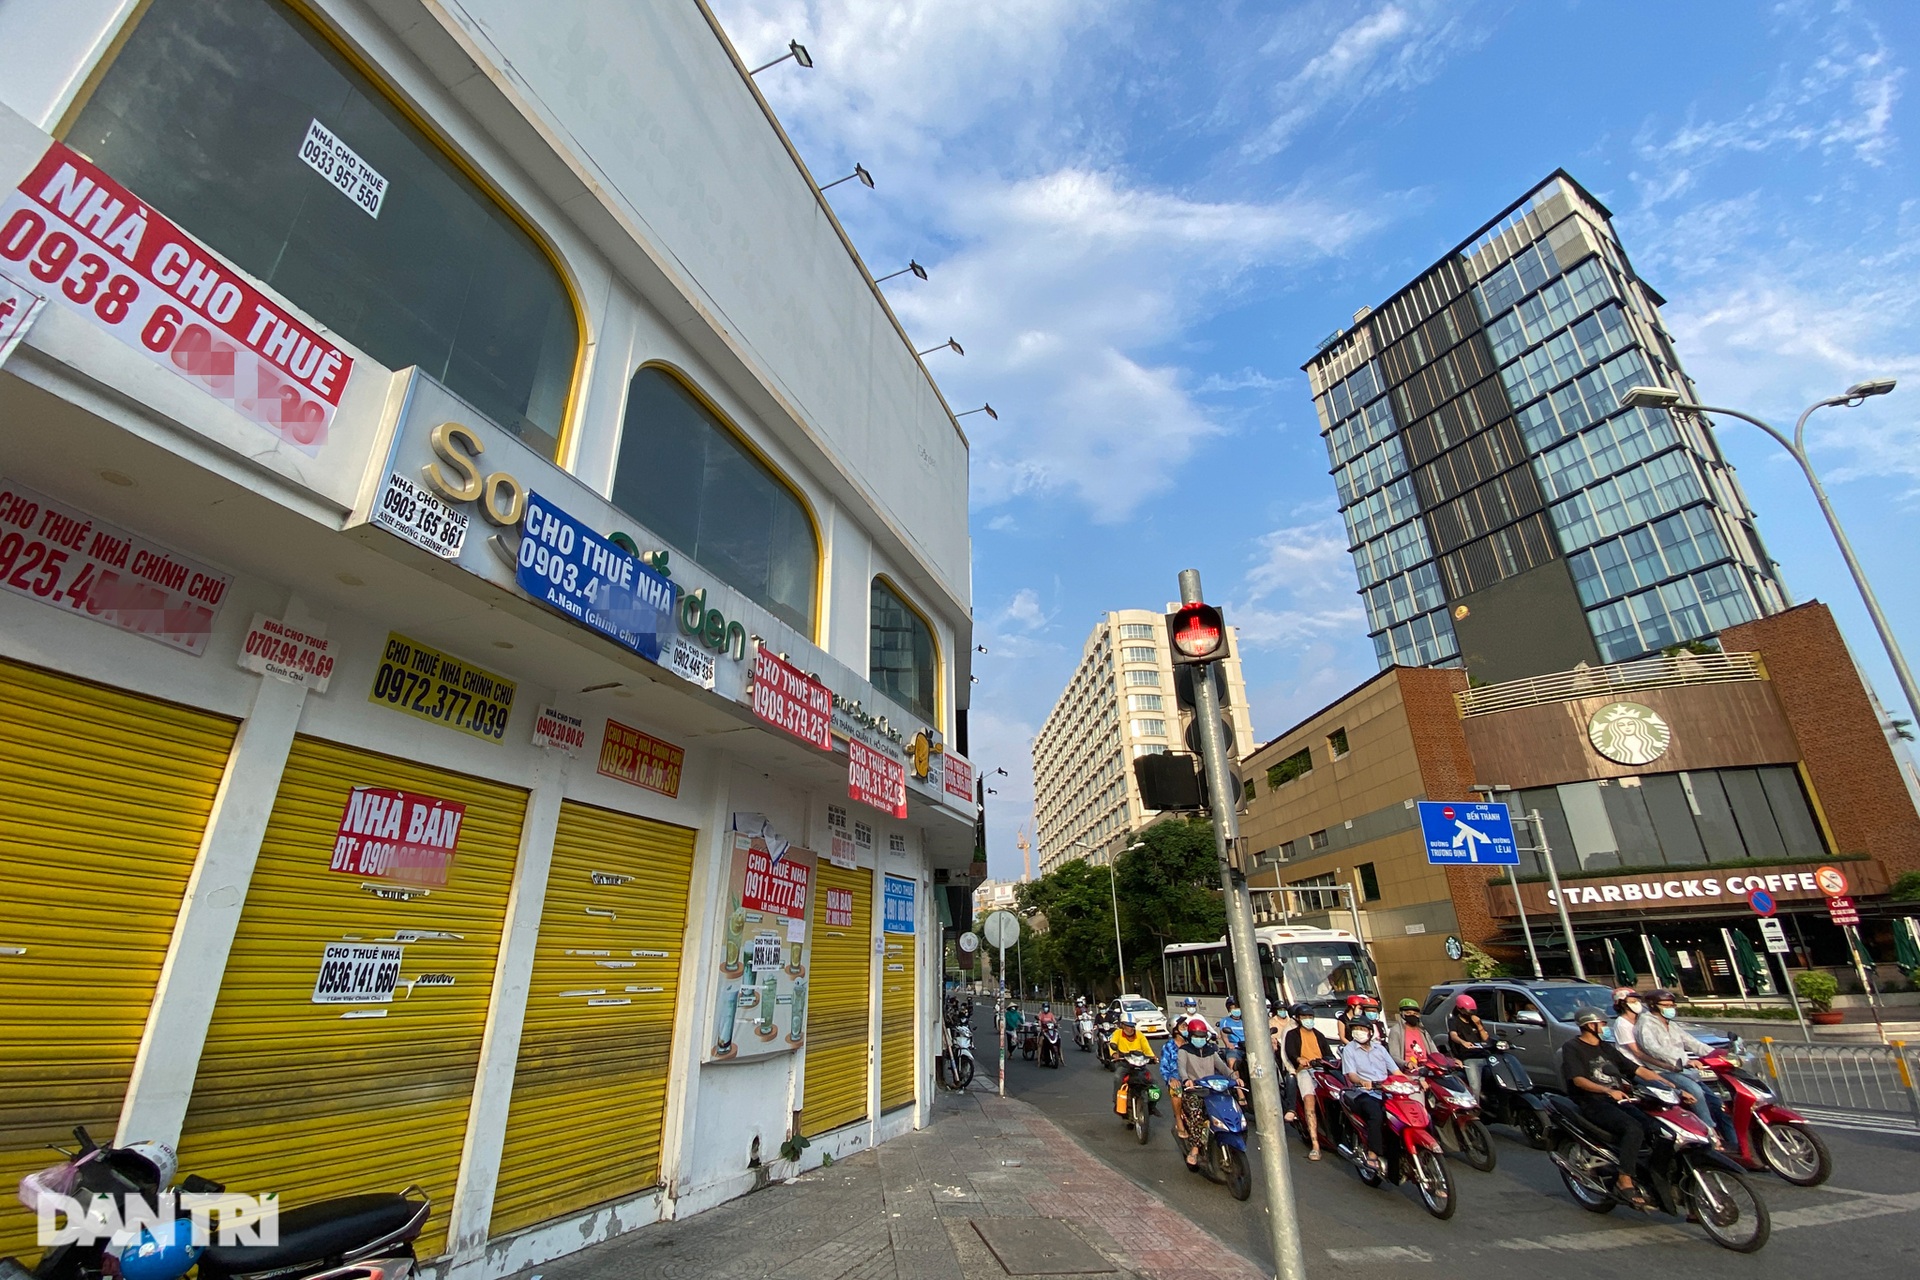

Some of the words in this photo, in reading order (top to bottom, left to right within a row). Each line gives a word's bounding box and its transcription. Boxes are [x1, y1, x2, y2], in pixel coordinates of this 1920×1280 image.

[303, 140, 335, 175] 0933
[334, 165, 358, 193] 957
[356, 184, 379, 212] 550
[311, 125, 334, 151] NHÀ
[335, 146, 356, 169] CHO
[358, 164, 384, 193] THUÊ
[0, 207, 140, 326] 0938
[38, 161, 148, 263] NHÀ
[150, 242, 243, 324] CHO
[245, 304, 344, 397] THUÊ
[383, 488, 417, 522] 0903
[415, 508, 442, 537] 165
[440, 521, 464, 549] 861
[389, 474, 414, 496] NHÀ
[416, 491, 439, 511] CHO
[441, 504, 468, 529] THUÊ
[377, 511, 395, 526] ANH
[394, 521, 419, 540] PHONG
[0, 491, 39, 530] CHO
[38, 509, 93, 552] THUÊ
[88, 532, 133, 570] NHÀ
[130, 550, 190, 592] CHÍNH
[187, 573, 226, 606] CHỦ
[525, 504, 576, 556] CHO
[581, 535, 634, 592] THUÊ
[636, 570, 672, 617] NHÀ
[547, 587, 582, 617] A.Nam
[245, 630, 334, 679] 0707.99.49.69
[263, 620, 284, 636] NHÀ
[283, 628, 304, 643] CHO
[304, 635, 329, 651] THUÊ
[675, 637, 688, 653] NHÀ
[688, 645, 700, 658] CHO
[265, 663, 288, 677] Chính
[288, 671, 304, 682] Chủ
[384, 639, 412, 666] CHO
[410, 649, 441, 678] THUÊ
[438, 662, 463, 687] NHÀ
[462, 670, 494, 700] CHÍNH
[493, 682, 516, 706] CHỦ
[755, 652, 780, 686] CHO
[781, 668, 809, 704] THUÊ
[809, 686, 829, 716] NHÀ
[373, 662, 510, 740] 0972.377.039
[545, 708, 557, 719] NHÀ
[557, 712, 569, 723] CHO
[568, 716, 582, 728] THUÊ
[753, 681, 829, 748] 0909.379.251
[536, 716, 557, 739] 0902
[555, 723, 567, 743] 30
[565, 726, 576, 746] 80
[607, 725, 622, 744] CHO
[621, 731, 638, 749] THUÊ
[602, 741, 679, 794] 0922.16.36.36
[850, 742, 866, 765] CHO
[867, 752, 887, 776] THUÊ
[342, 790, 404, 840] NHÀ
[405, 800, 462, 850] BÁN
[1466, 810, 1480, 821] BẾN
[1480, 810, 1501, 821] THÀNH
[331, 835, 360, 872] ĐT:
[748, 853, 767, 873] CHO
[790, 866, 807, 884] NHÀ
[744, 870, 806, 910] 0911.7777.69
[1725, 872, 1817, 895] COFFE
[326, 947, 350, 959] CHO
[352, 946, 379, 960] THUÊ
[380, 947, 401, 961] NHÀ
[318, 960, 399, 994] 0936.141.660
